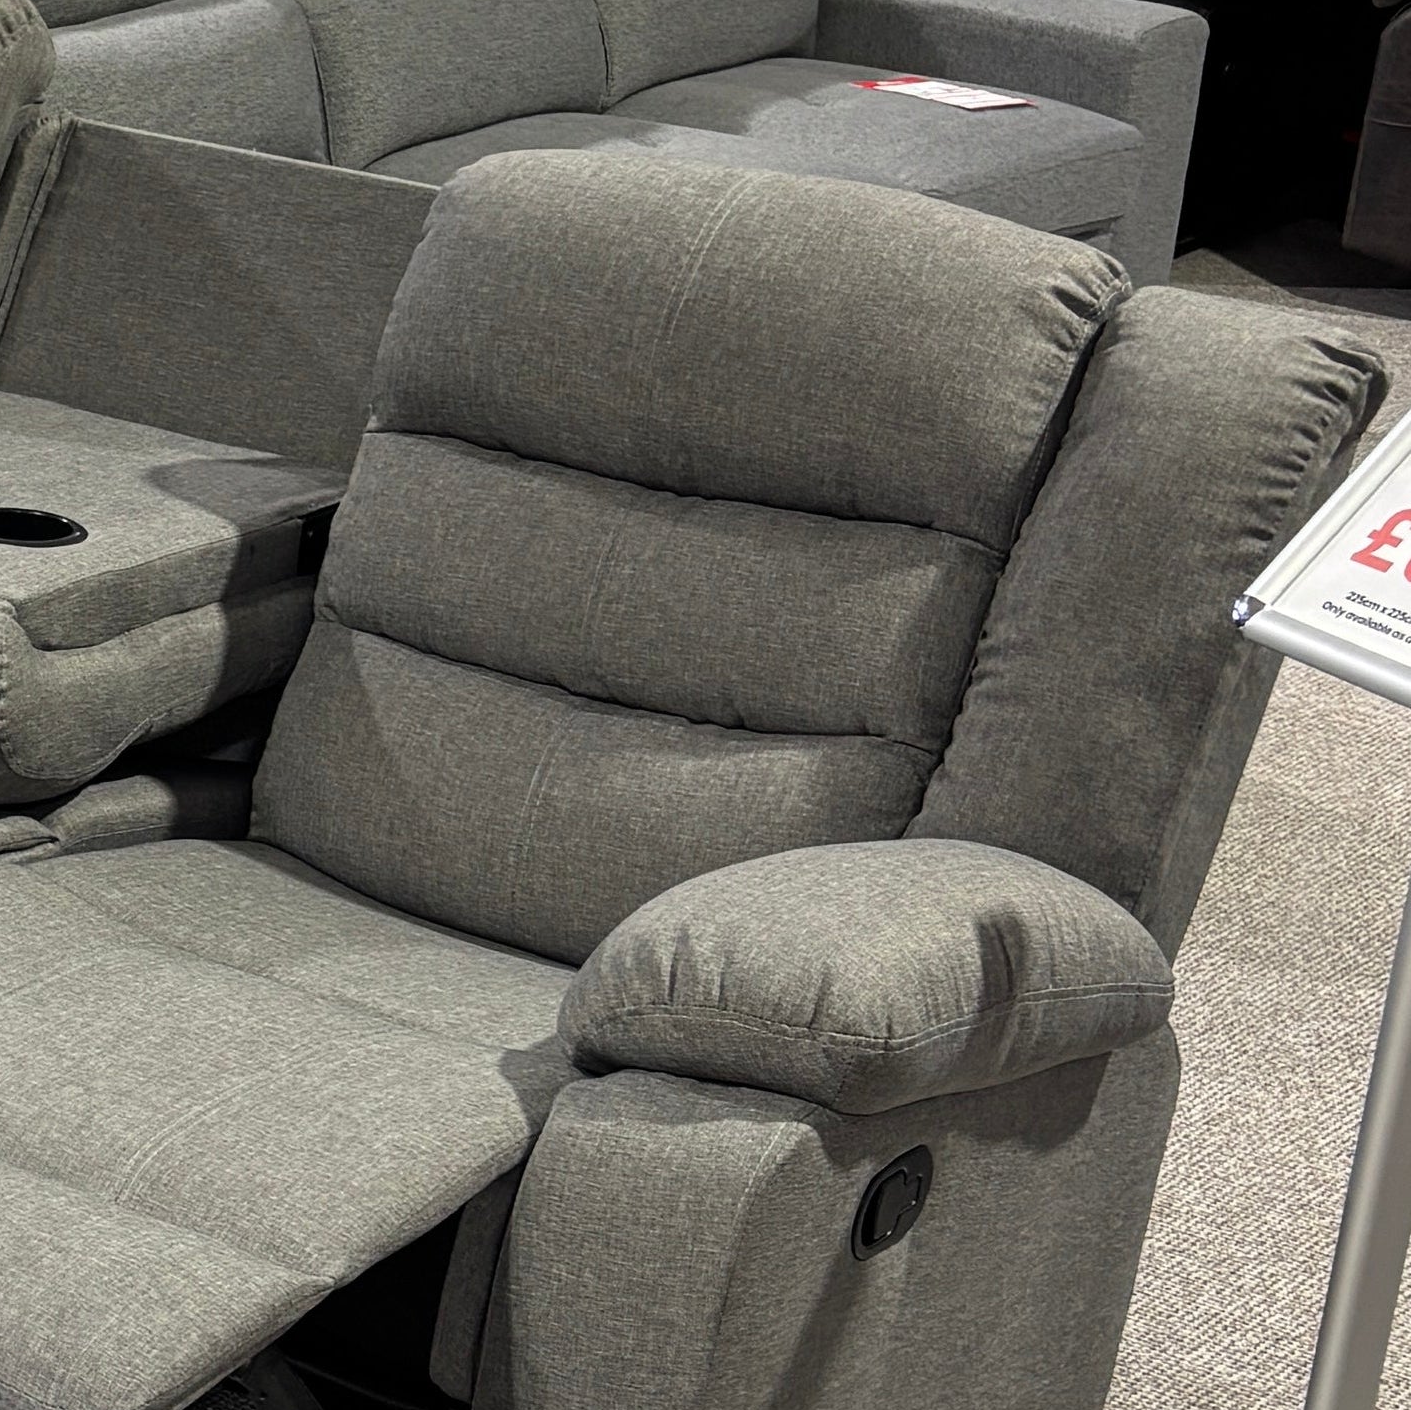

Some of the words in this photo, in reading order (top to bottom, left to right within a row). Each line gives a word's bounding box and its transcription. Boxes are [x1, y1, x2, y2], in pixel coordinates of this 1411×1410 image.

[1322, 601, 1347, 619] Only
[1345, 612, 1393, 635] available
[1391, 630, 1406, 645] as
